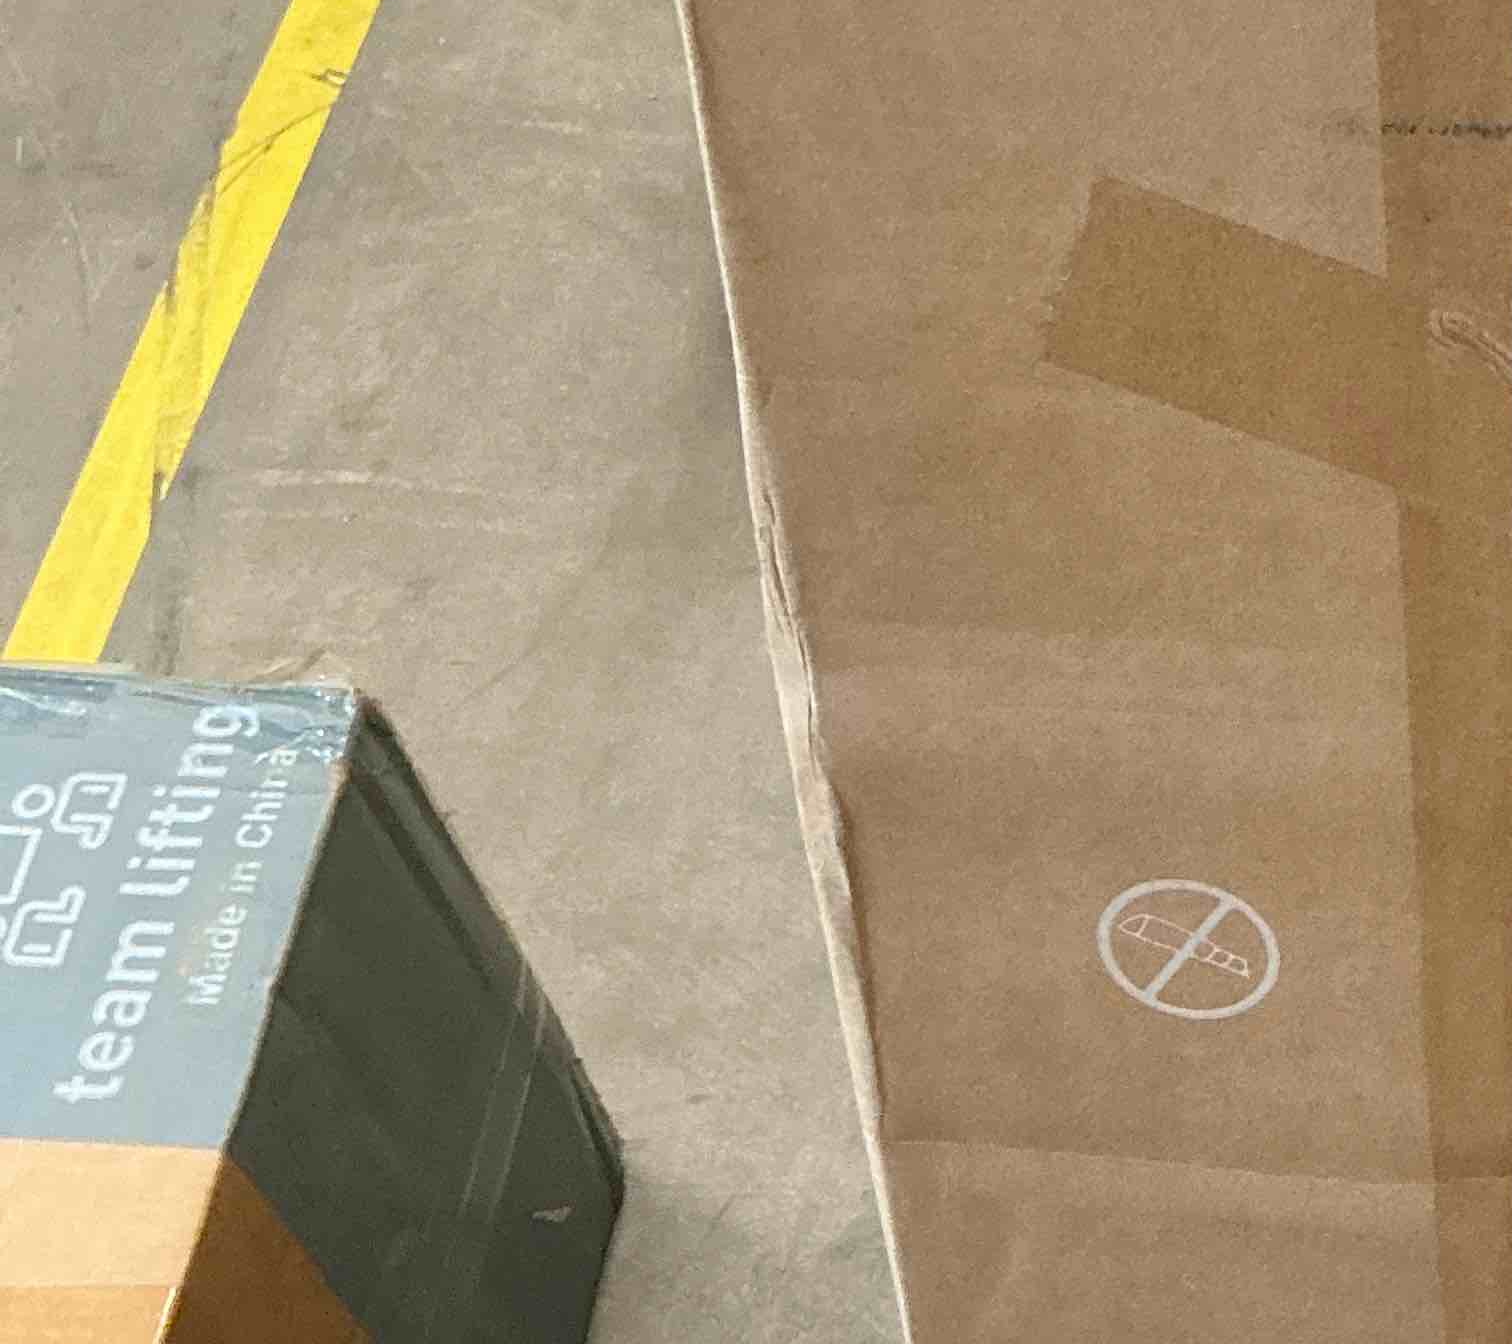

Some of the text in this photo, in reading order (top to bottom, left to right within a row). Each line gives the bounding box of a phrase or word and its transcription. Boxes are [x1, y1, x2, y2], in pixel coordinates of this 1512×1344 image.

[53, 703, 260, 1104] team lifting
[186, 744, 300, 1007] Made in China
